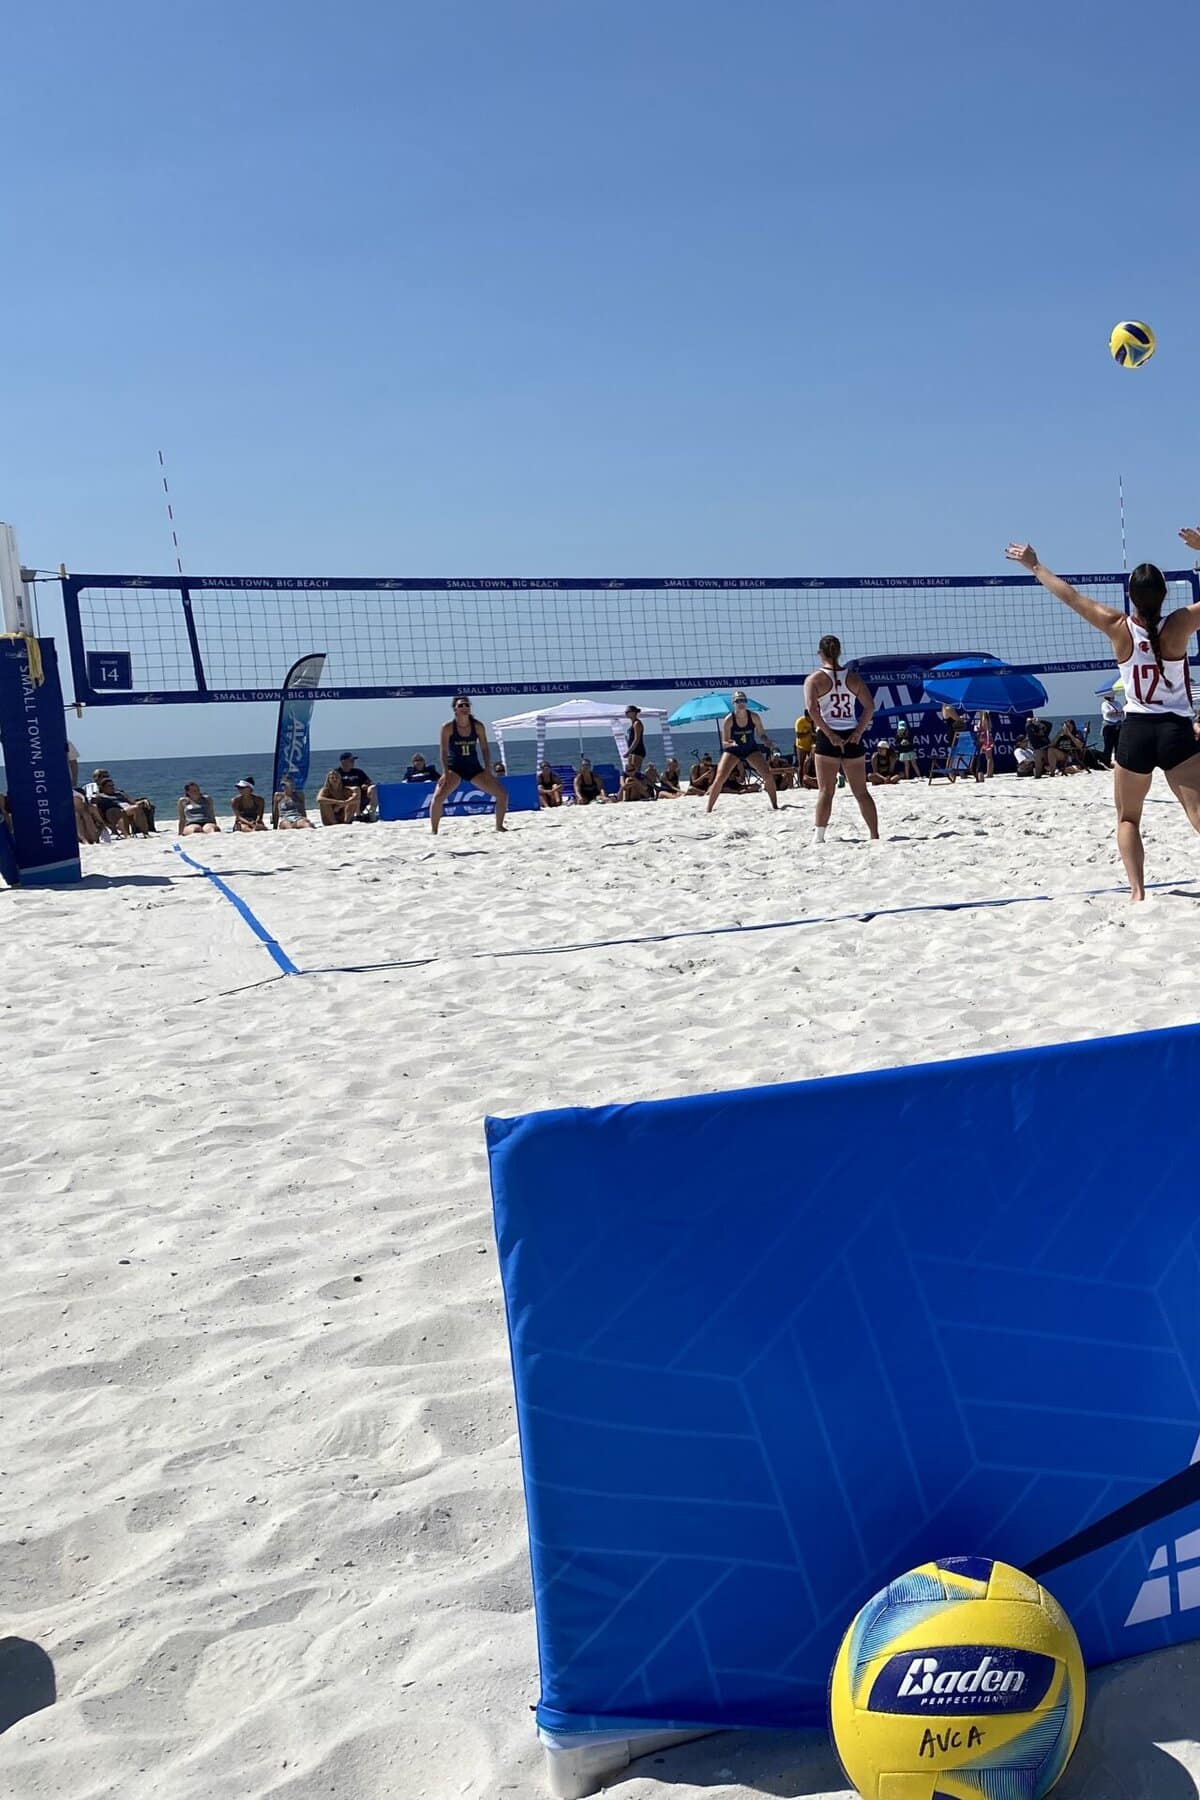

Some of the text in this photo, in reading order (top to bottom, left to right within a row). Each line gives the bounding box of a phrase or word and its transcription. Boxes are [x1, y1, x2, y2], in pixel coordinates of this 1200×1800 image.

[201, 579, 329, 588] SMALL TOWN, BIG BEACH
[446, 580, 475, 588] SMALL
[512, 580, 527, 588] BIG
[663, 579, 691, 587] SMALL
[723, 579, 737, 587] BIG
[739, 579, 766, 587] BEACH
[859, 578, 884, 586] SMALL
[912, 578, 925, 586] BIG
[926, 578, 950, 586] BEACH
[101, 667, 120, 681] 14
[870, 673, 895, 682] SMALL
[923, 671, 936, 680] BIG
[937, 671, 960, 679] BEACH
[674, 680, 702, 688] SMALL
[734, 678, 748, 687] BIG
[750, 678, 776, 686] BEACH
[1132, 663, 1164, 705] 12
[456, 687, 486, 695] SMALL
[523, 685, 538, 693] BIG
[541, 684, 570, 692] BEACH
[213, 693, 247, 701] SMALL
[288, 691, 305, 699] BIG
[308, 690, 340, 699] BEACH
[830, 693, 853, 718] 33
[20, 665, 54, 845] SMALL TOWN, BIG BEACH
[462, 744, 470, 756] 11
[897, 1656, 1024, 1697] Baden
[920, 1696, 1000, 1706] PERFECTION
[918, 1726, 986, 1758] AVCA
